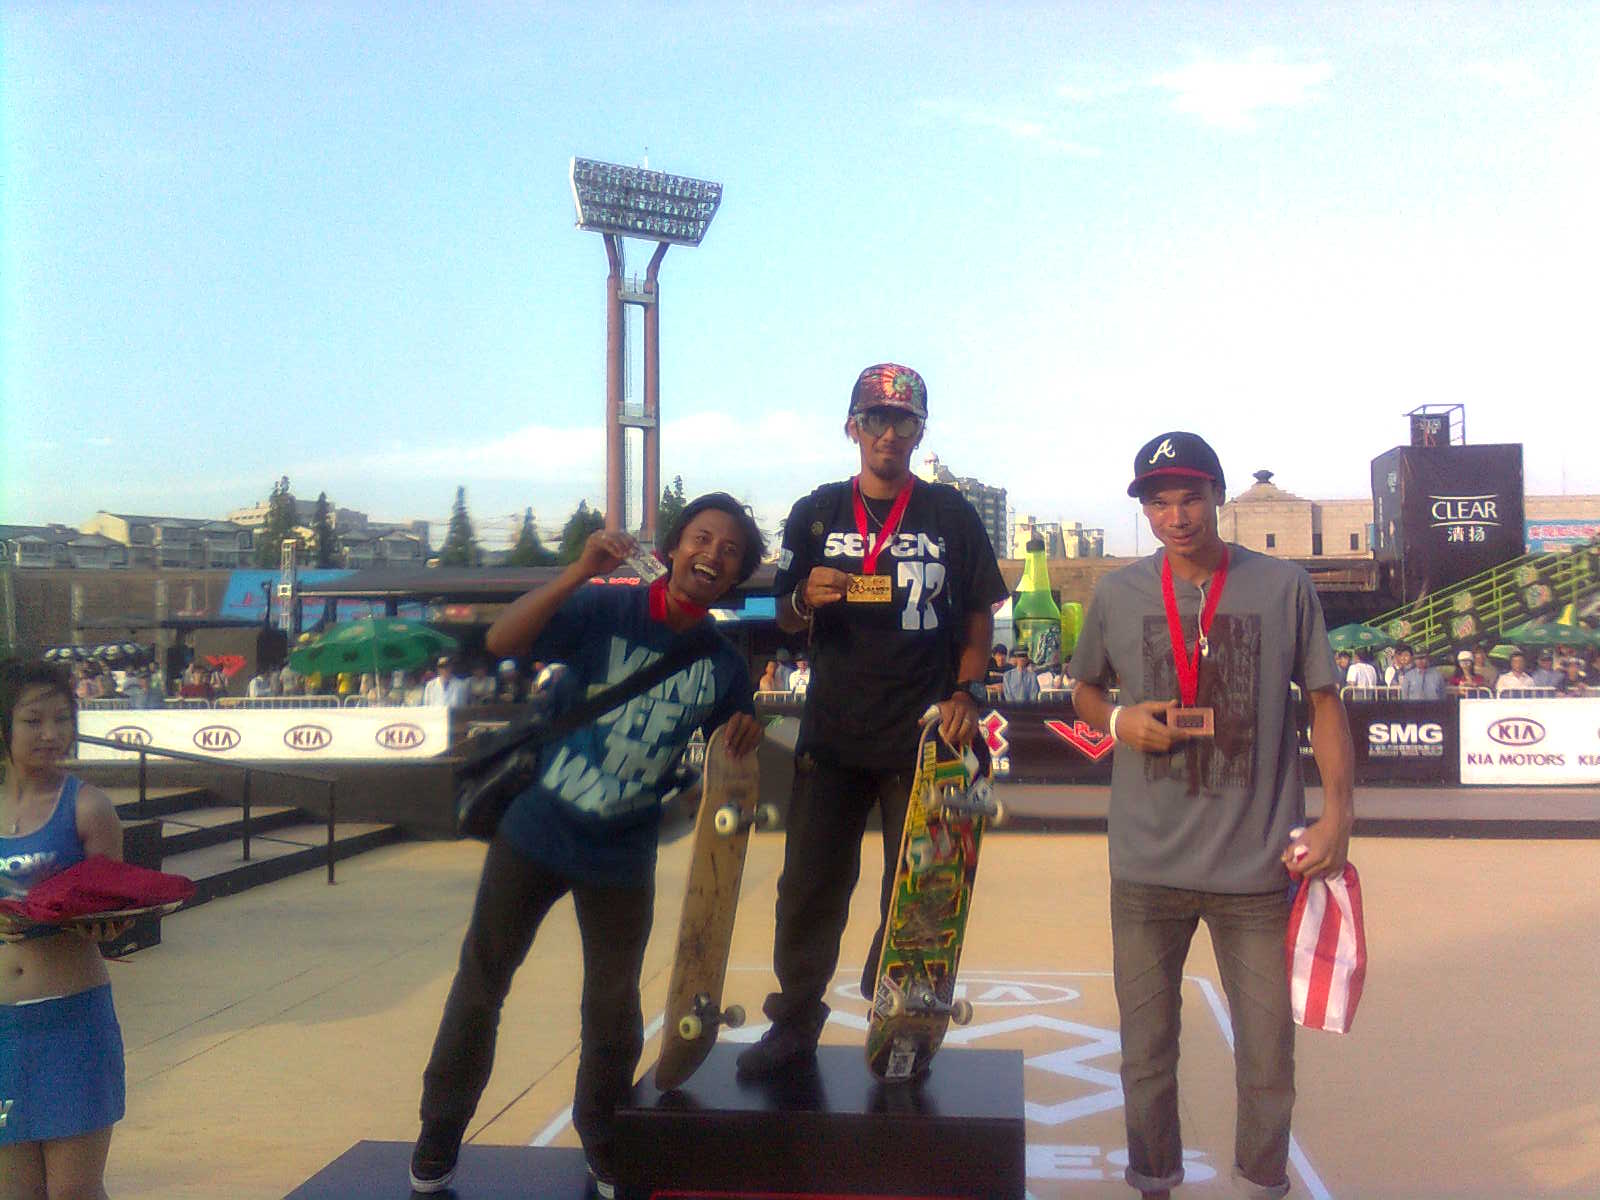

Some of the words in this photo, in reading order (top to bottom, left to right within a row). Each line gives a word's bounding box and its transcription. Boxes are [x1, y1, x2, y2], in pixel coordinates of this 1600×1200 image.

[1149, 438, 1176, 465] A
[1431, 500, 1498, 520] CLEAR
[202, 731, 232, 746] KIA
[293, 731, 324, 745] KIA
[386, 730, 417, 744] KIA
[1368, 722, 1444, 744] SMG
[1498, 725, 1536, 740] KIA
[1467, 753, 1494, 766] KIA
[1499, 753, 1566, 766] MOTORS
